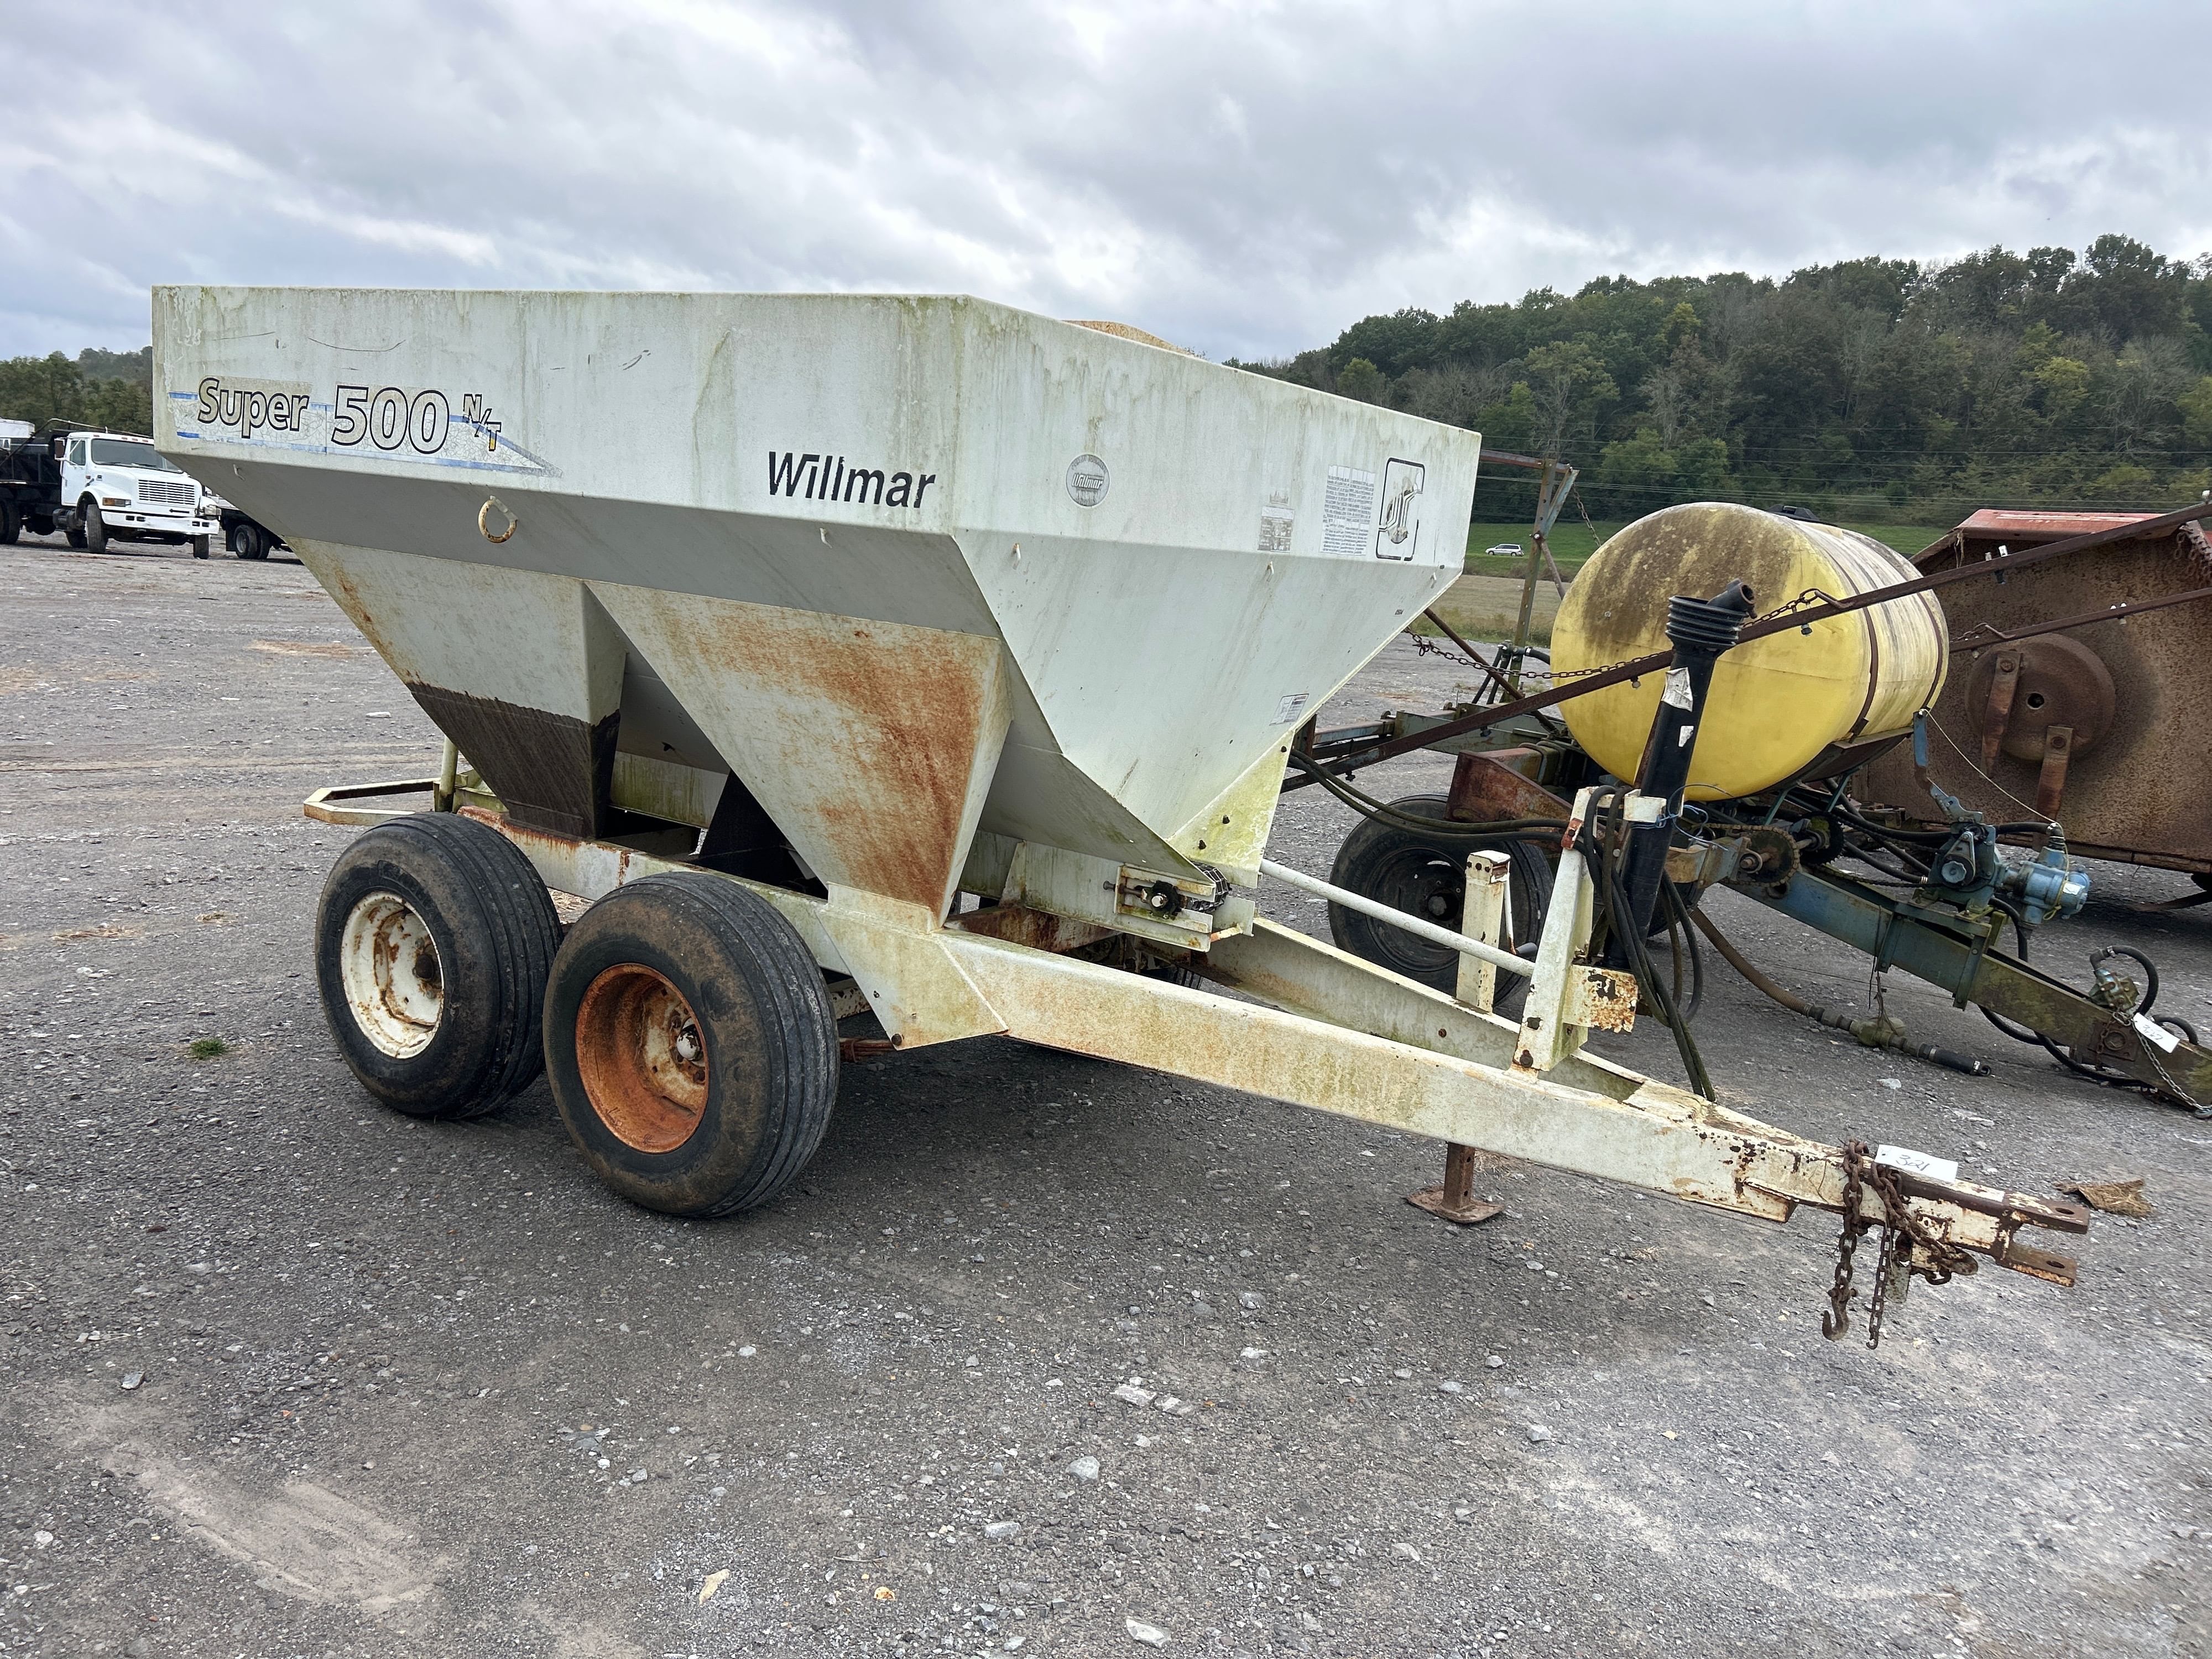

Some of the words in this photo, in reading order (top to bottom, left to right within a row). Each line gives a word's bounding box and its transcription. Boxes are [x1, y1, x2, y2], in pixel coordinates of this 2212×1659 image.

[197, 377, 310, 439] Super
[331, 385, 450, 453] 500
[769, 451, 936, 508] Willmar
[1896, 1154, 1930, 1171] 321
